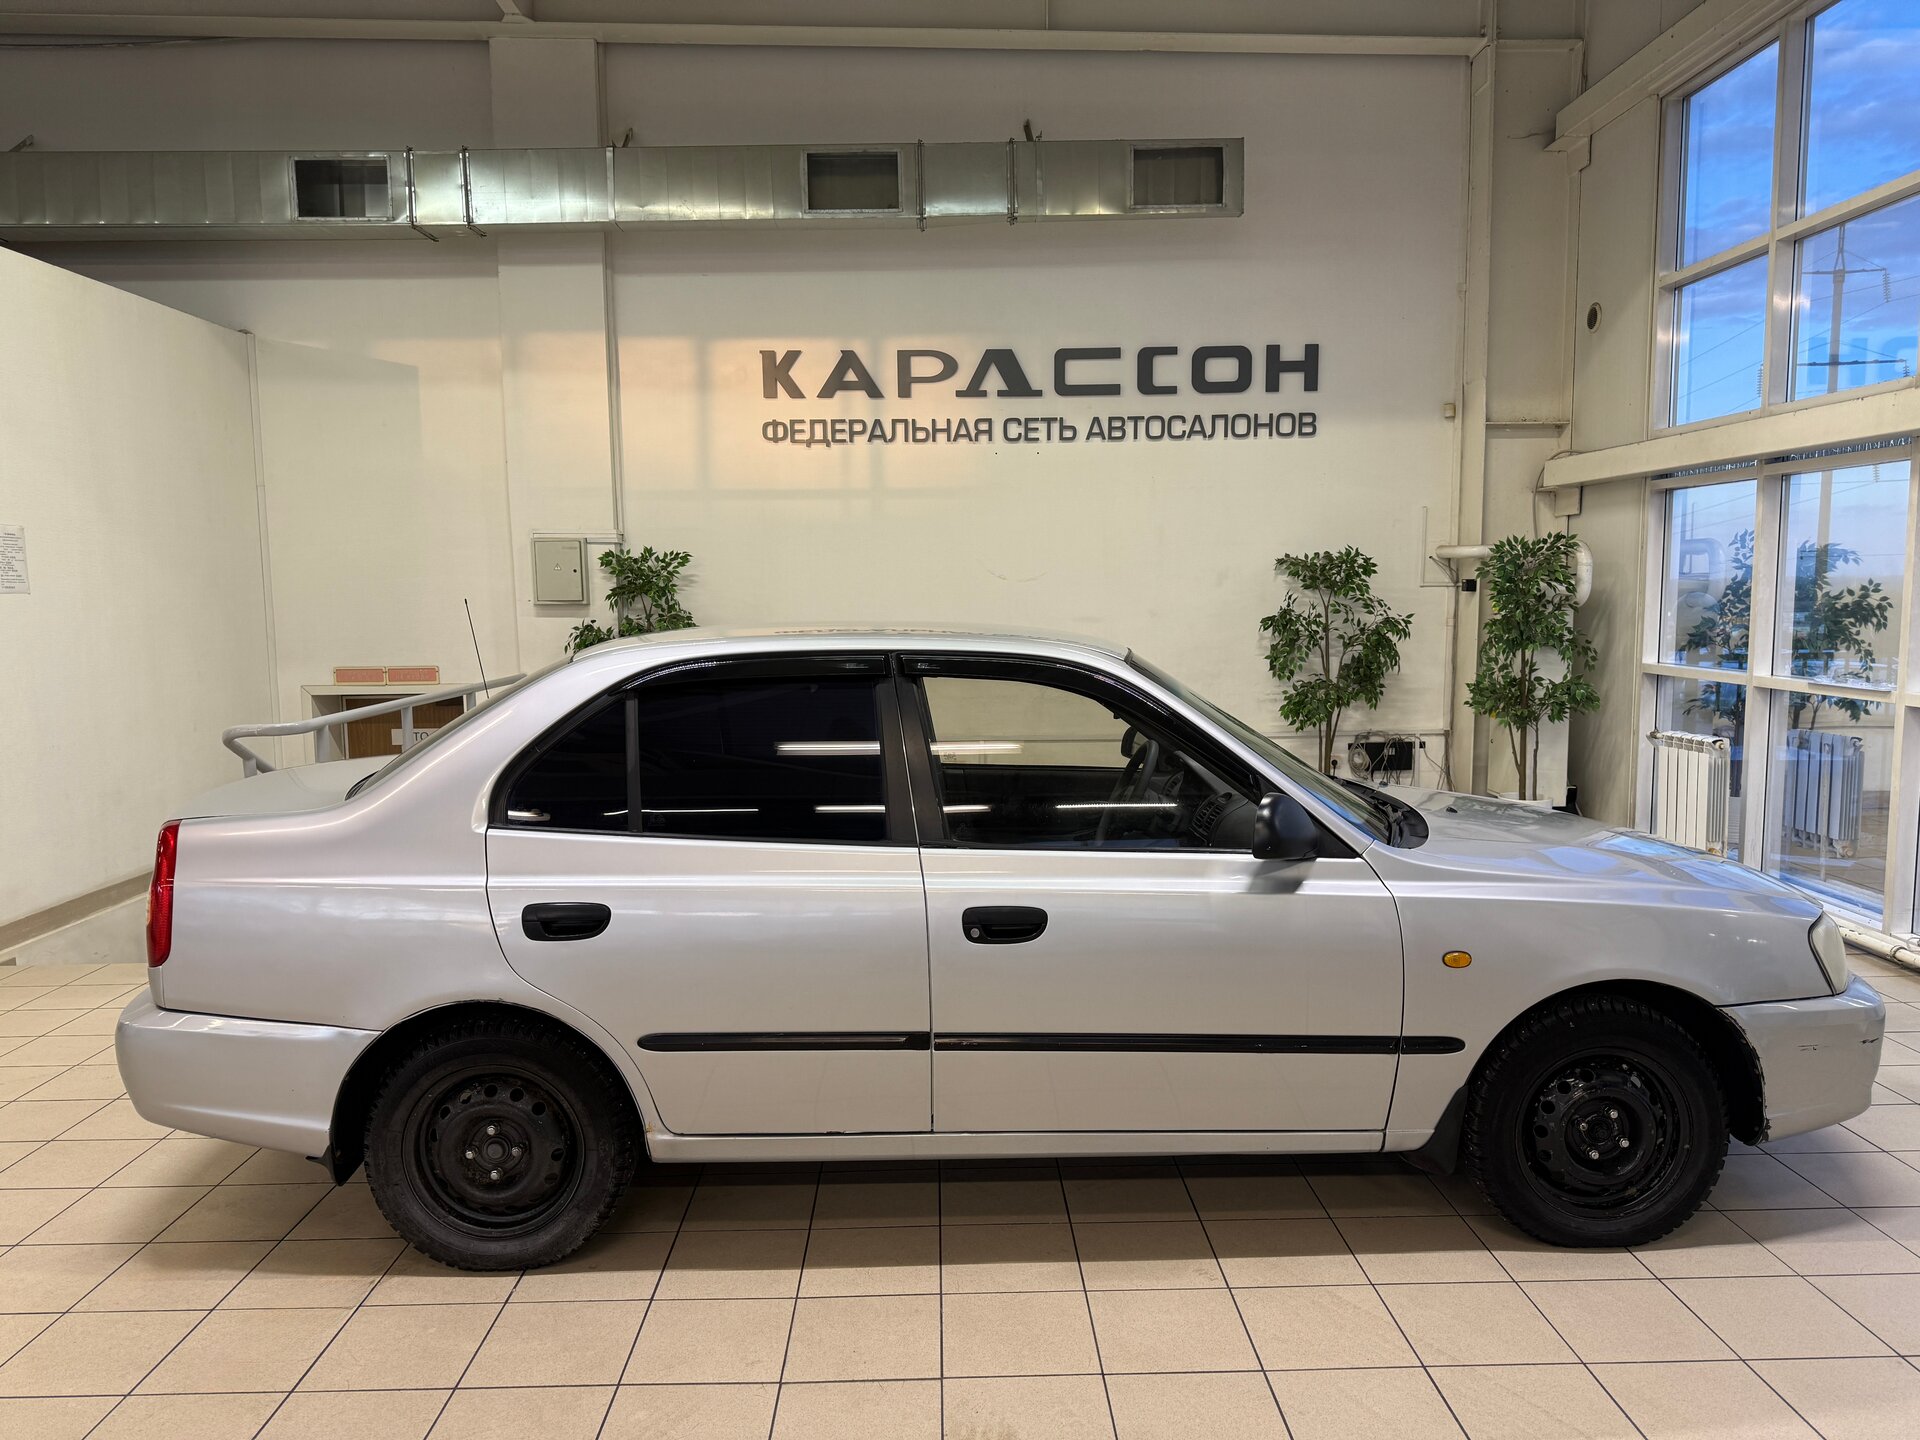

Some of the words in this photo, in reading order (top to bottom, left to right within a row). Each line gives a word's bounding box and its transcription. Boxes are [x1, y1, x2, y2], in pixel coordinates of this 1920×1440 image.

[759, 343, 1320, 399] КАРЛССОН
[762, 417, 994, 449] ФЕДЕРАЛЬНАЯ
[1002, 416, 1078, 443] СЕТЬ
[1085, 412, 1318, 442] АВТОСАЛОНОВ
